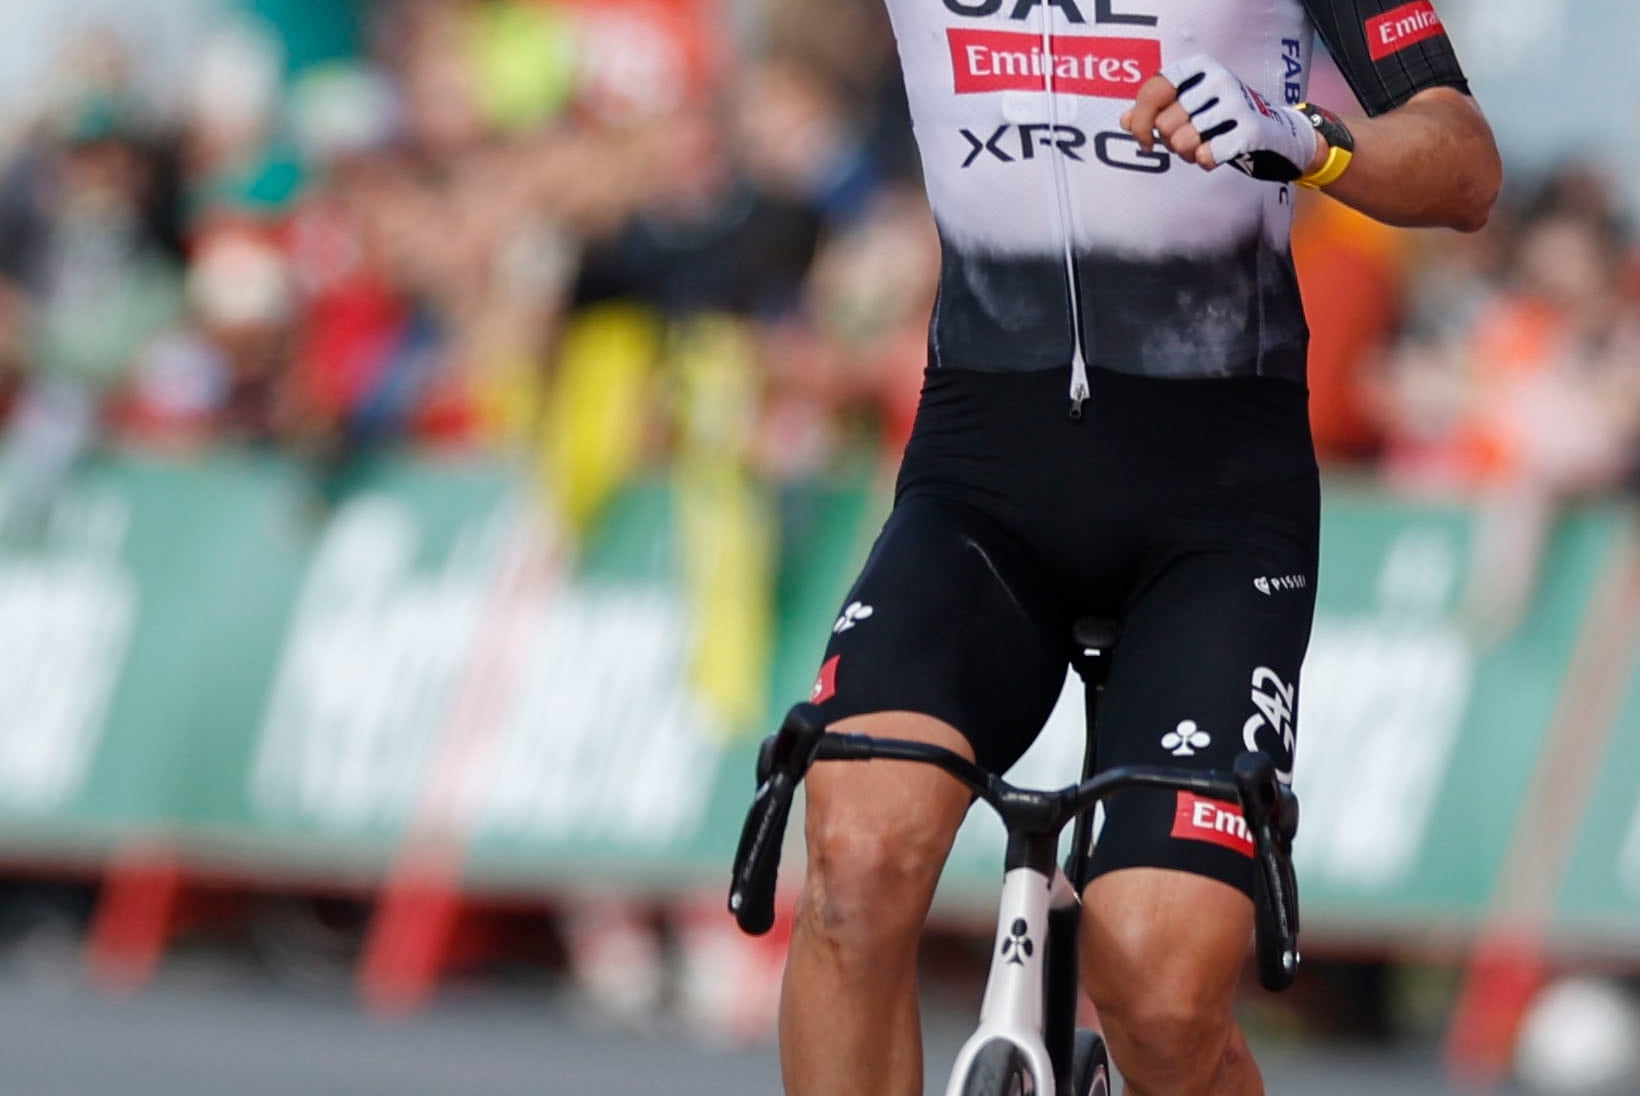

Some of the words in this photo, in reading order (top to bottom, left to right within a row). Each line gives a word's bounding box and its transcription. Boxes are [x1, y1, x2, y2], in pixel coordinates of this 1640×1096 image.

[965, 45, 1142, 83] Emirates
[1281, 37, 1302, 104] FAB
[958, 123, 1171, 174] XRG
